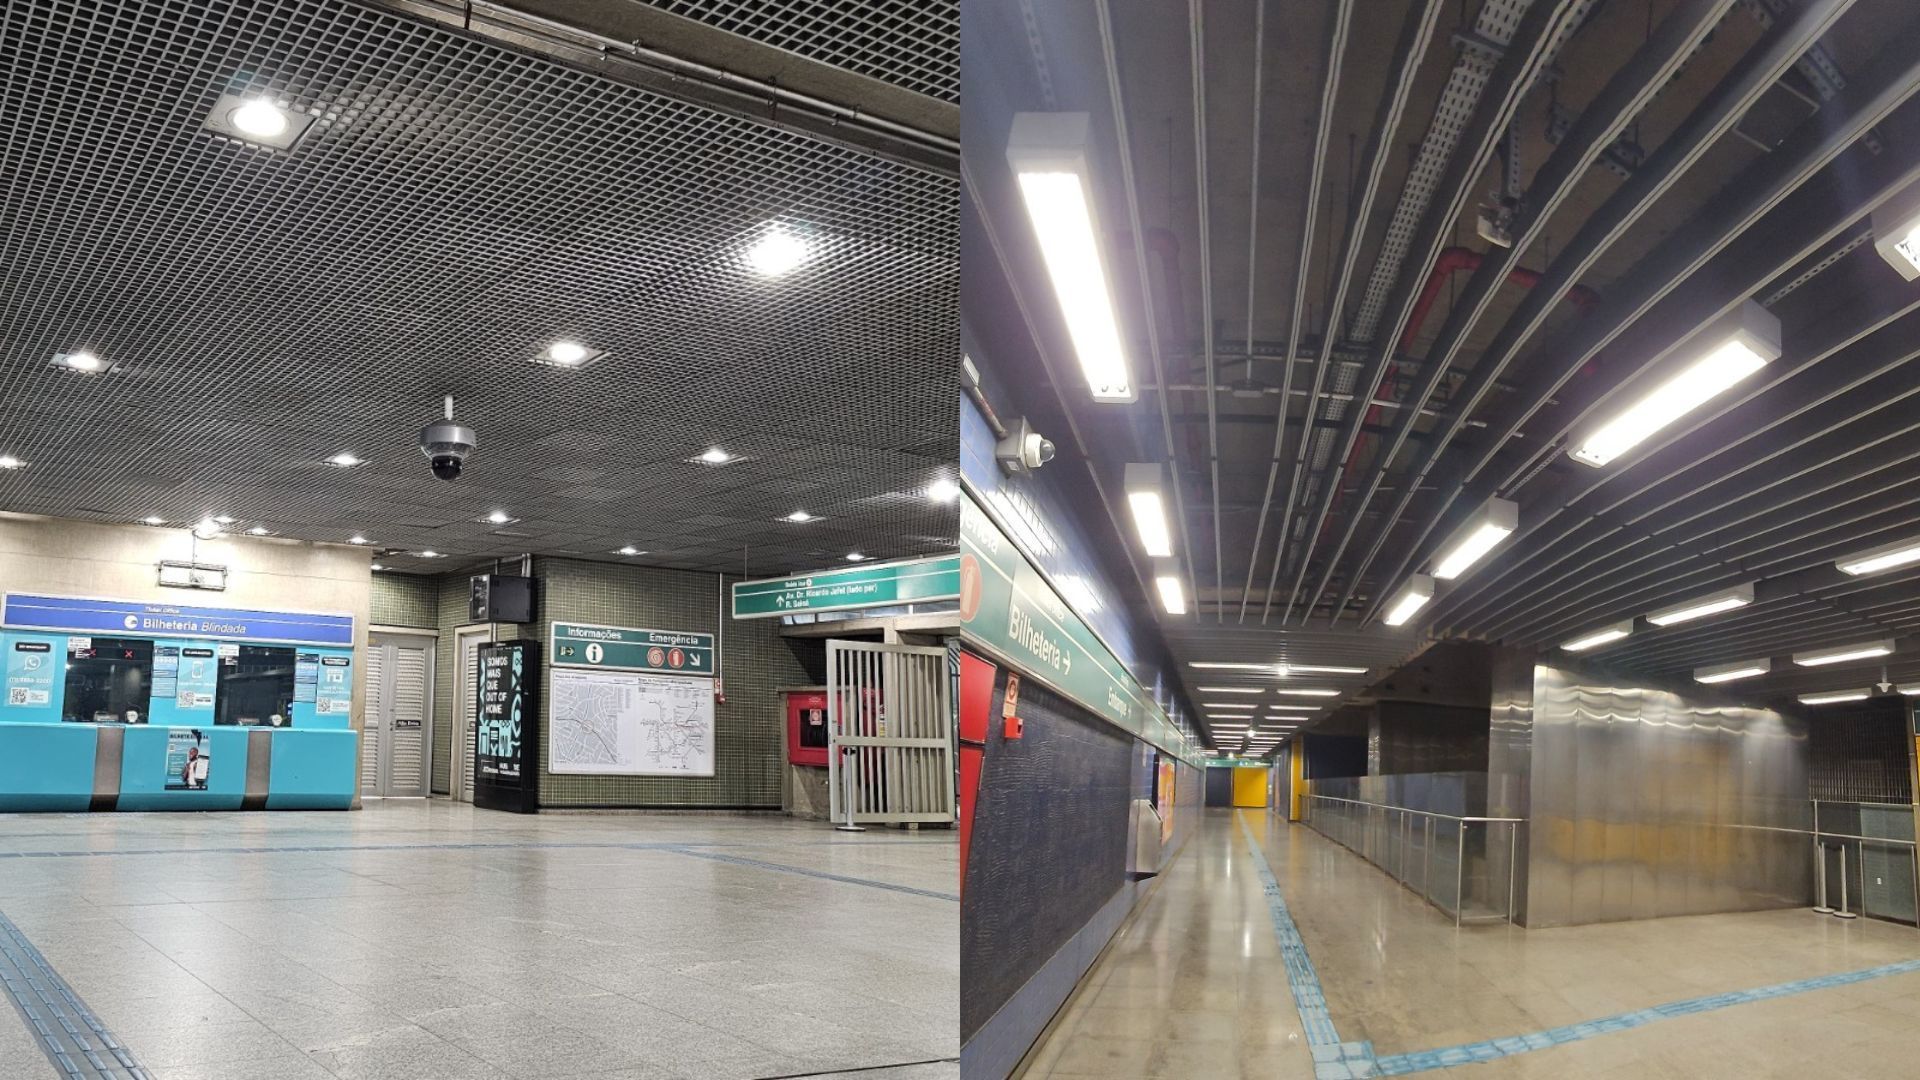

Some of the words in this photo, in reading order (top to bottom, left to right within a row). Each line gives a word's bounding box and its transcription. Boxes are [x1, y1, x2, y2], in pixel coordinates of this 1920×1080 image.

[796, 591, 805, 599] Dr.
[806, 588, 829, 597] Ricardo
[143, 618, 198, 631] Bilheteria
[201, 621, 246, 634] Blindada
[568, 627, 622, 641] Informações
[650, 633, 698, 646] Emergência
[1008, 608, 1061, 671] Bilheteria
[487, 656, 508, 667] SOMOS
[486, 668, 501, 678] MAIS
[486, 680, 498, 690] QUE
[486, 692, 498, 702] OUT
[498, 692, 507, 702] OF
[485, 704, 503, 714] HOME
